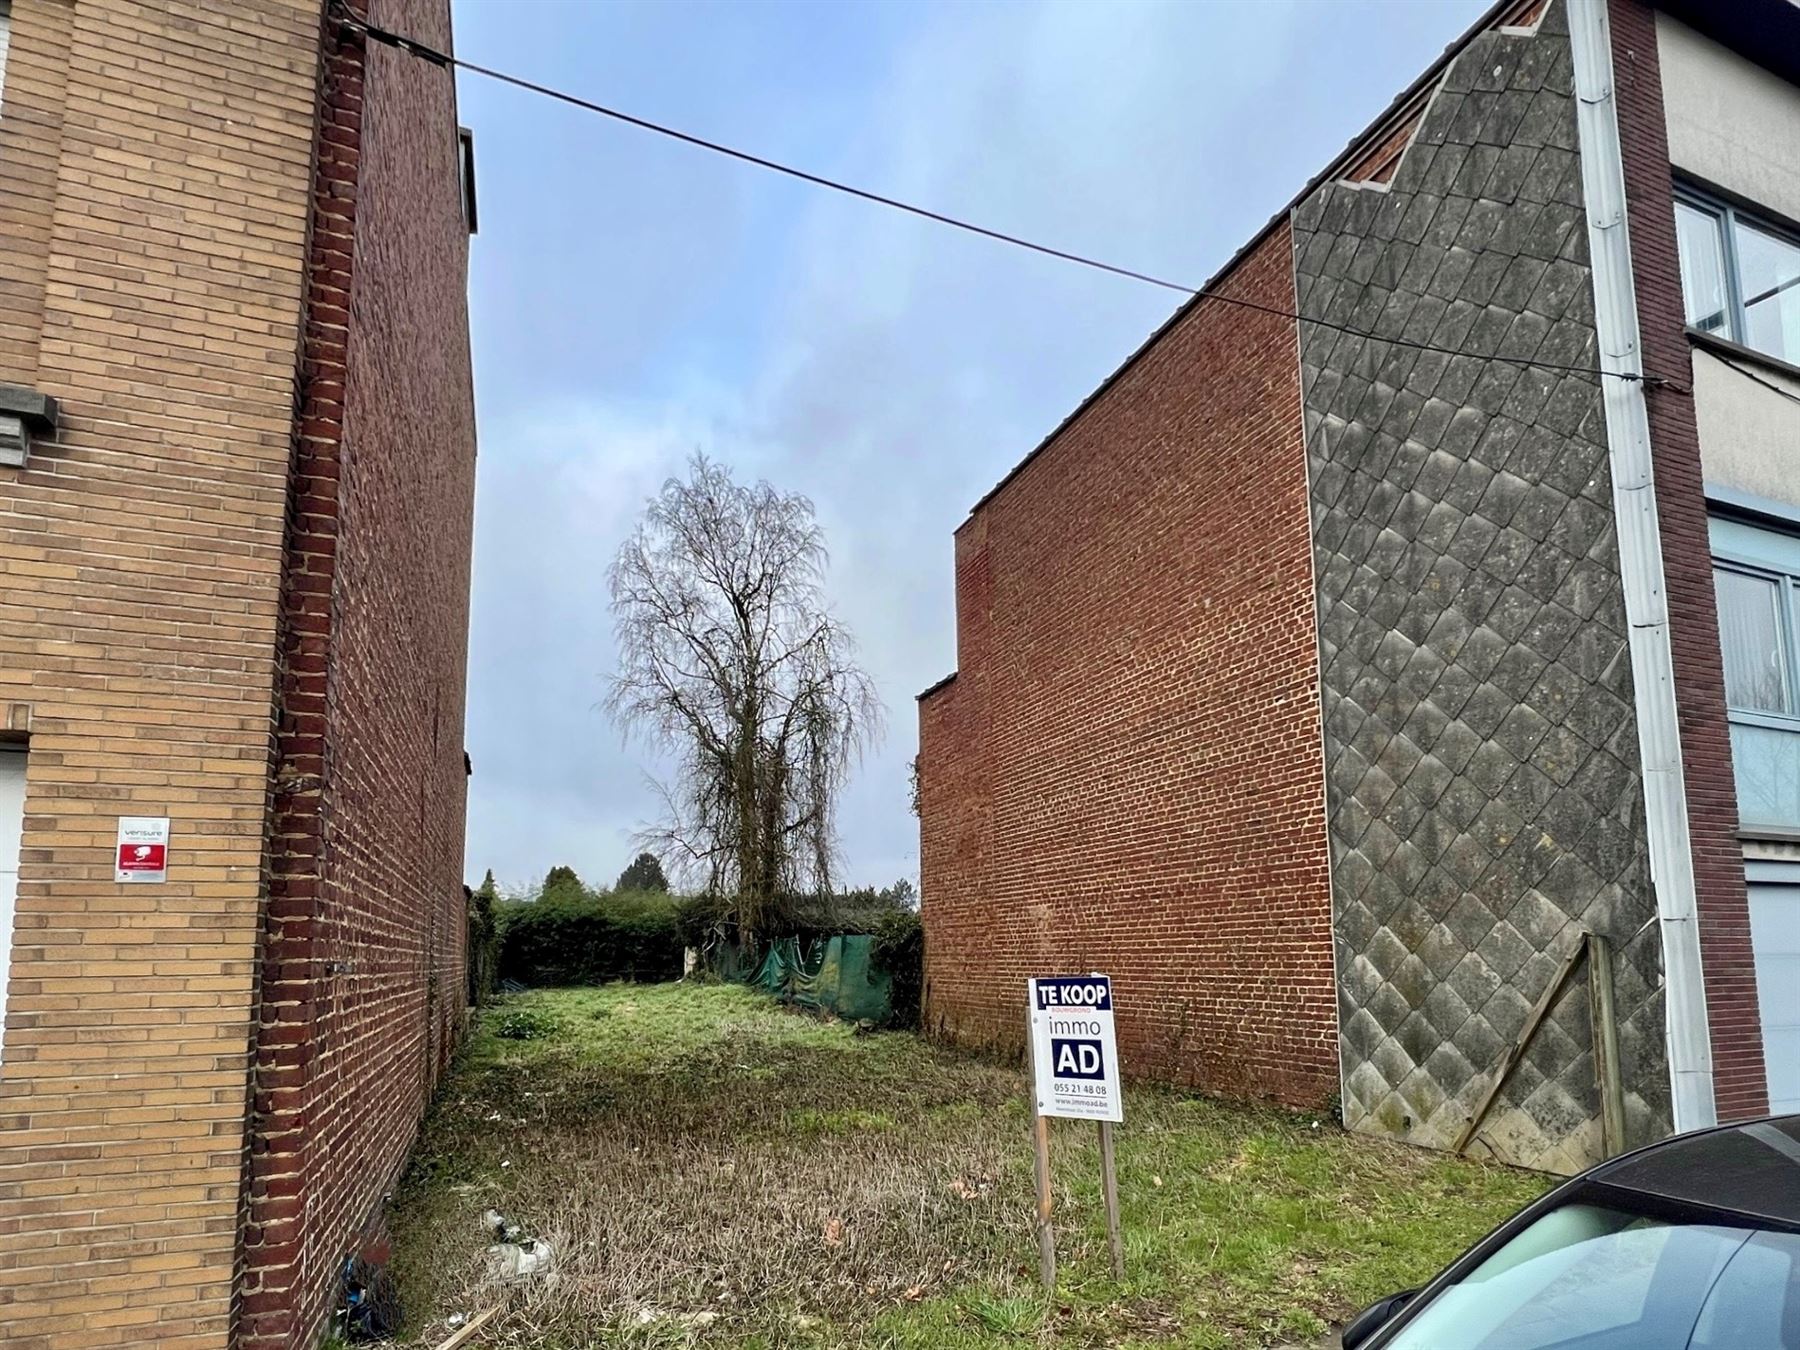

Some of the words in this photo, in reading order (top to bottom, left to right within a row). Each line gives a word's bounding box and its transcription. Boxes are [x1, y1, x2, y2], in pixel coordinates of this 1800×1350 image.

[1038, 986, 1058, 1005] TE
[1060, 985, 1107, 1005] KOOP
[1049, 1016, 1101, 1036] immo
[1057, 1044, 1100, 1075] AD
[1054, 1083, 1070, 1093] 055
[1071, 1084, 1081, 1094] 21
[1083, 1085, 1094, 1095] 48
[1096, 1085, 1107, 1095] 08
[1055, 1097, 1108, 1108] www.immoad.be
